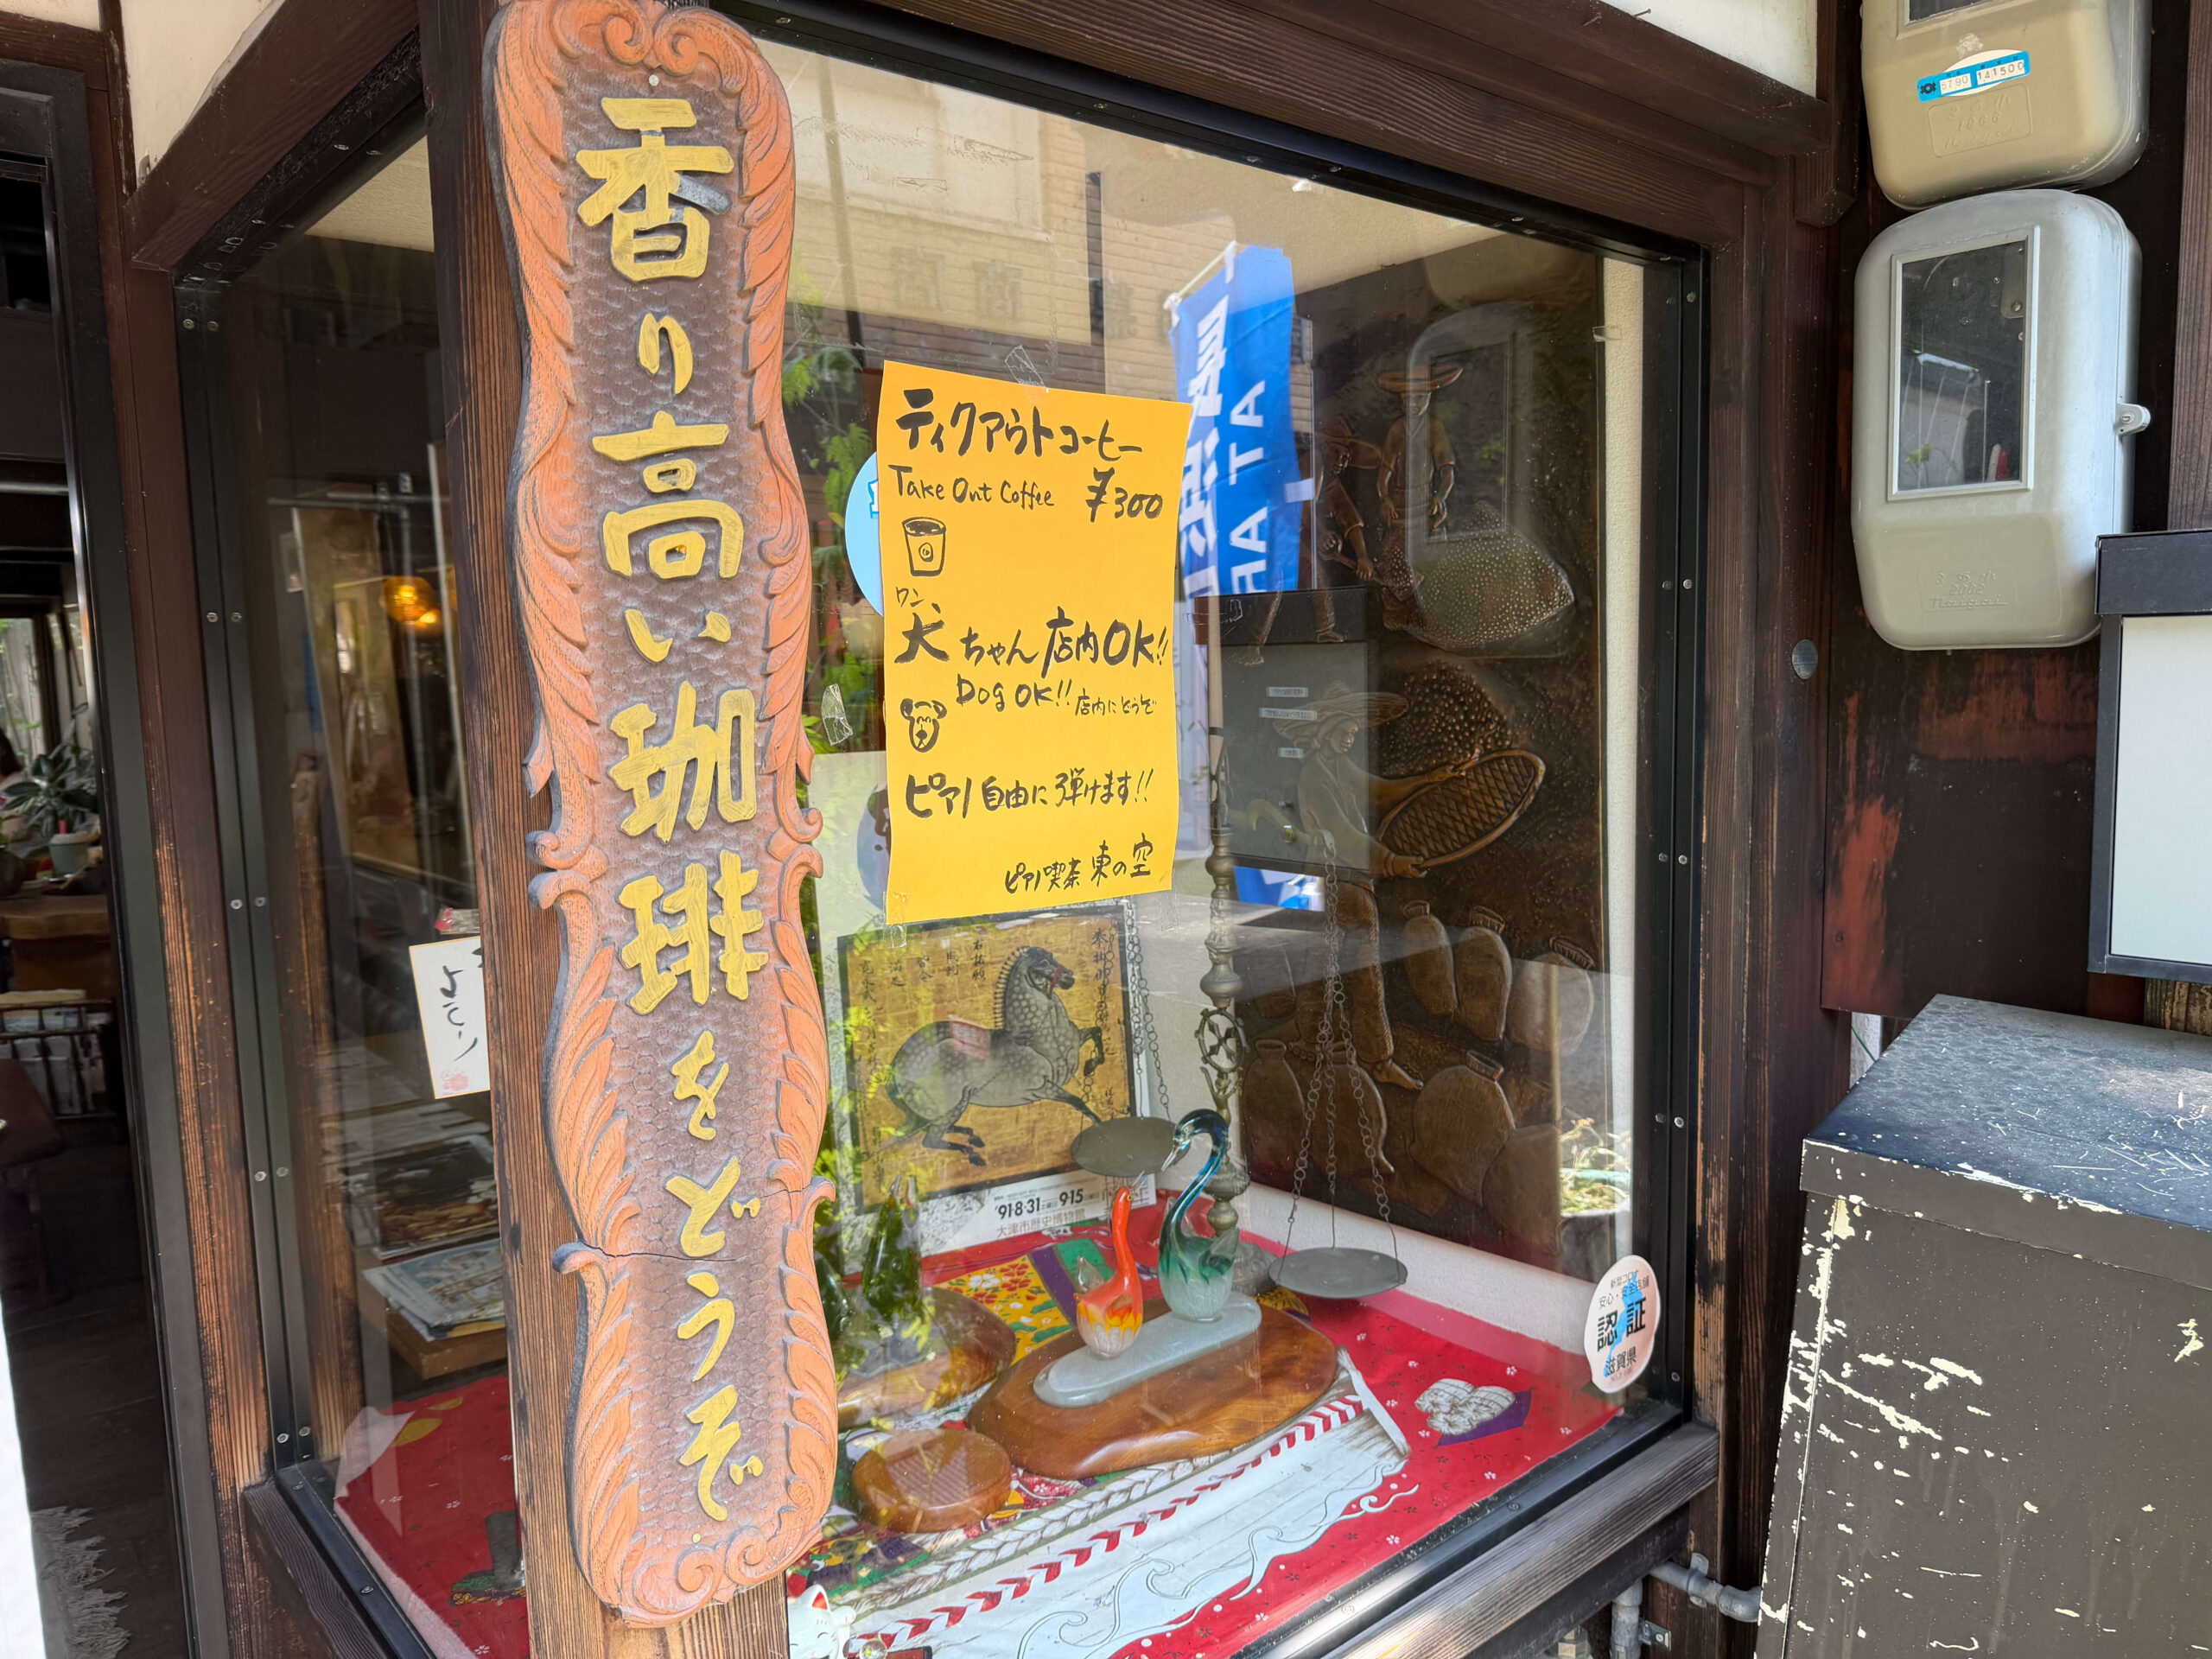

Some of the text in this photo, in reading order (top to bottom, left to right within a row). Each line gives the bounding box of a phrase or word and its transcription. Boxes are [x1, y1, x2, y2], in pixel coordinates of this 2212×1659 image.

[887, 464, 946, 502] Take
[951, 477, 993, 503] Out
[1000, 480, 1055, 510] Coffee
[1084, 467, 1163, 523] ¥300
[895, 587, 925, 608] ワン
[956, 673, 1073, 713] Dog OK!!
[1075, 689, 1157, 716] 店内にどうぞ
[576, 97, 768, 1522] 香り高い珈琲をどうぞ
[997, 1208, 1086, 1237] 大津市歴史博物館
[1596, 1296, 1647, 1352] 認証
[1605, 1345, 1637, 1376] 滋賀県
